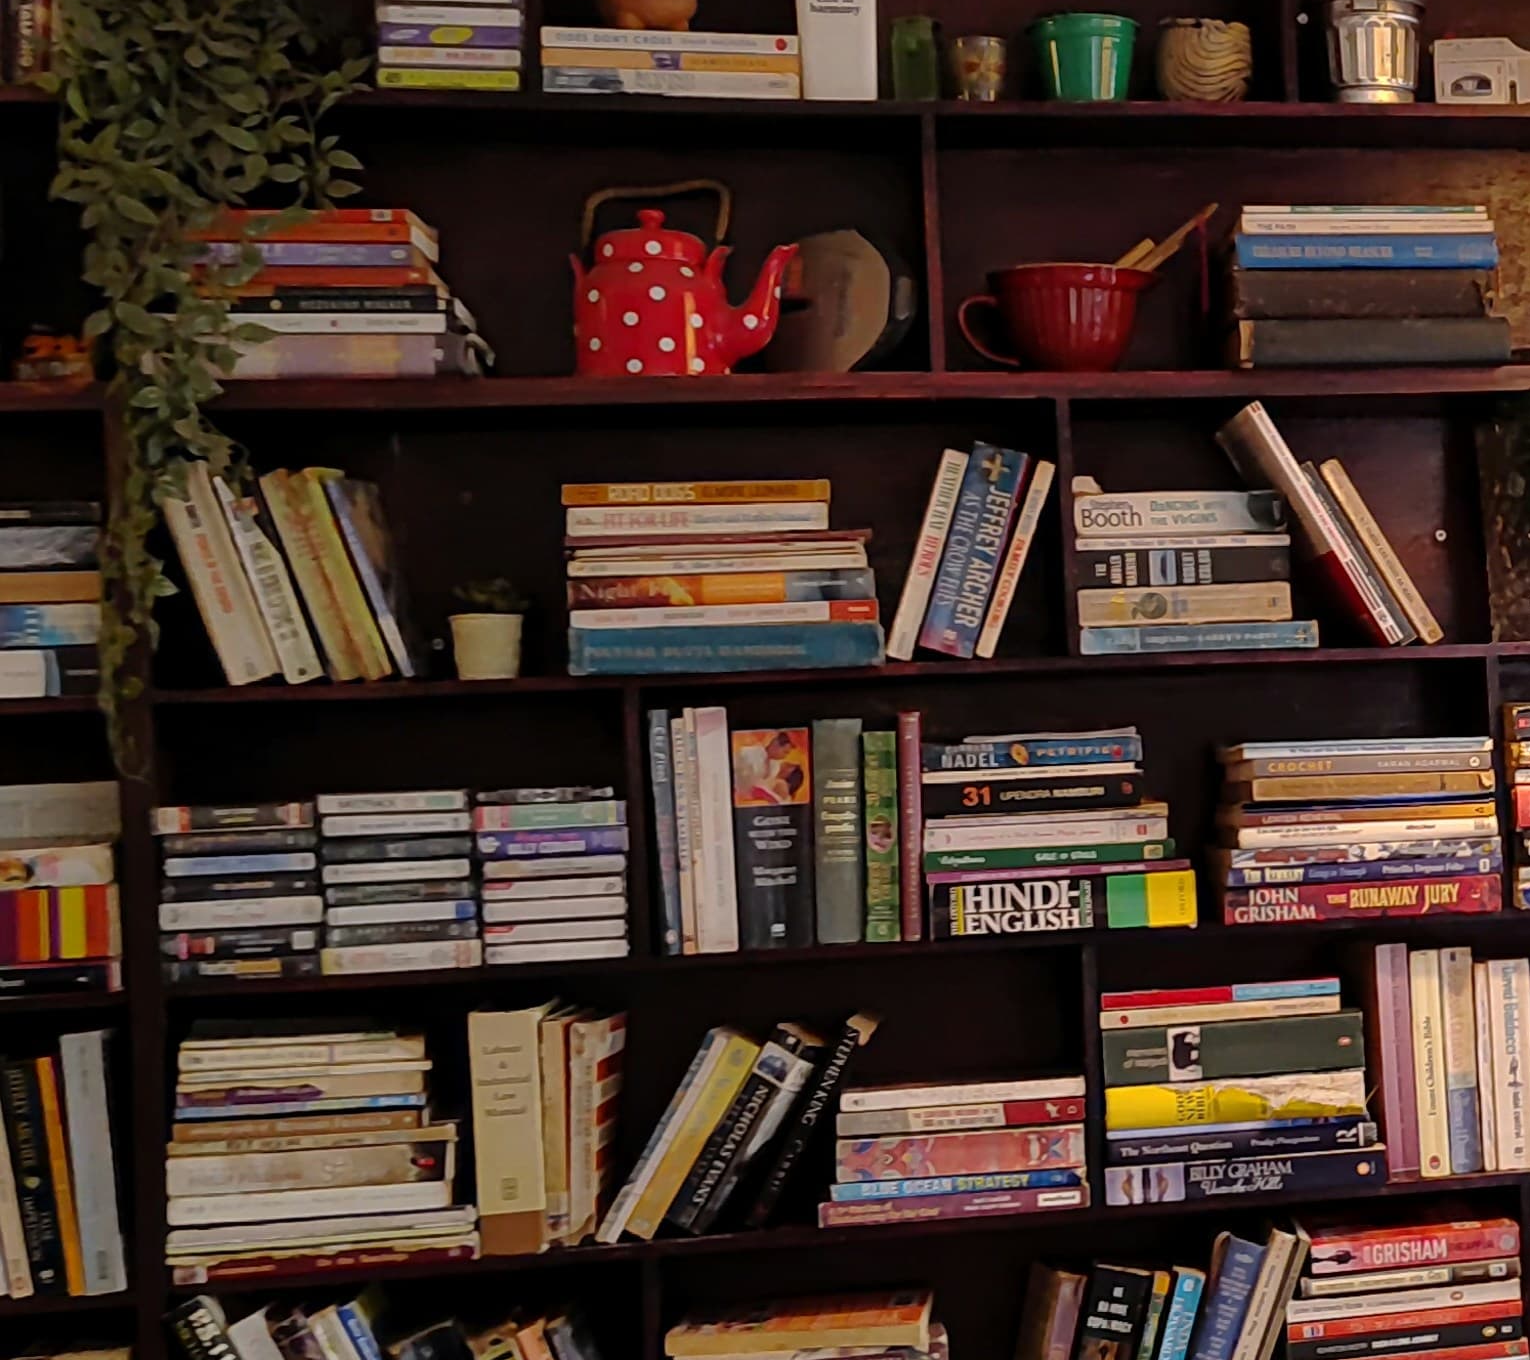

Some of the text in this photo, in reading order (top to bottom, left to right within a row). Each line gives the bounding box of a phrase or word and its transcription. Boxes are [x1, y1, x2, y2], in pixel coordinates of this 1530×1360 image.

[1081, 504, 1142, 528] Booth
[953, 484, 1013, 630] JEFFREY ARCHER
[940, 752, 999, 769] NADEL
[1266, 760, 1333, 773] CROCHET
[961, 785, 993, 807] 31
[1247, 888, 1299, 906] JOHN
[1349, 886, 1419, 909] RUNAWAY
[1420, 882, 1461, 915] JURY
[964, 908, 1080, 936] ENGLISH
[1234, 904, 1317, 924] GRISHAM
[691, 1159, 728, 1206] EVANS
[1187, 1160, 1295, 1183] BILLY GRAHAM
[861, 1175, 1030, 1194] BLUE OCEAN STRATEGY
[1373, 1239, 1449, 1266] GRISHAM
